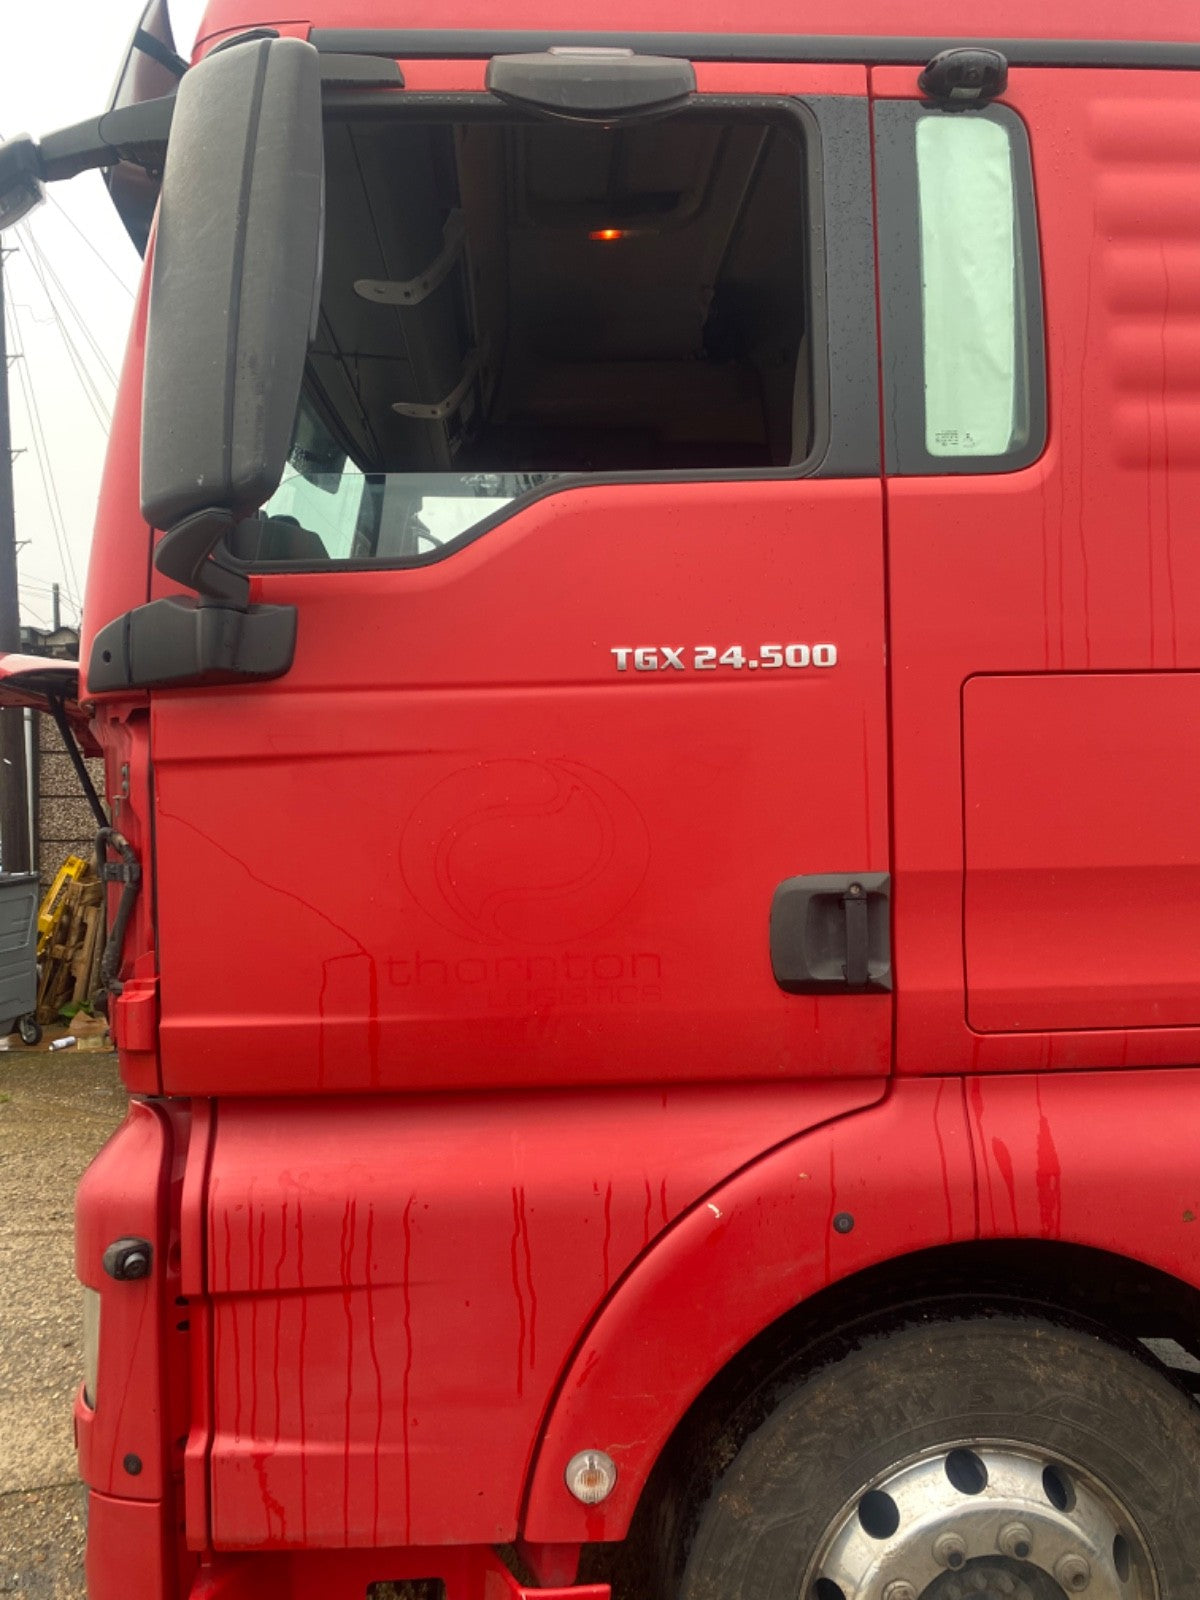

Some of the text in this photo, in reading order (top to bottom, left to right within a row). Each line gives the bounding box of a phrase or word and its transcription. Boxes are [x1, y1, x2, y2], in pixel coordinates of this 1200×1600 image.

[610, 643, 838, 671] TGX 24.500
[383, 950, 662, 985] thornton
